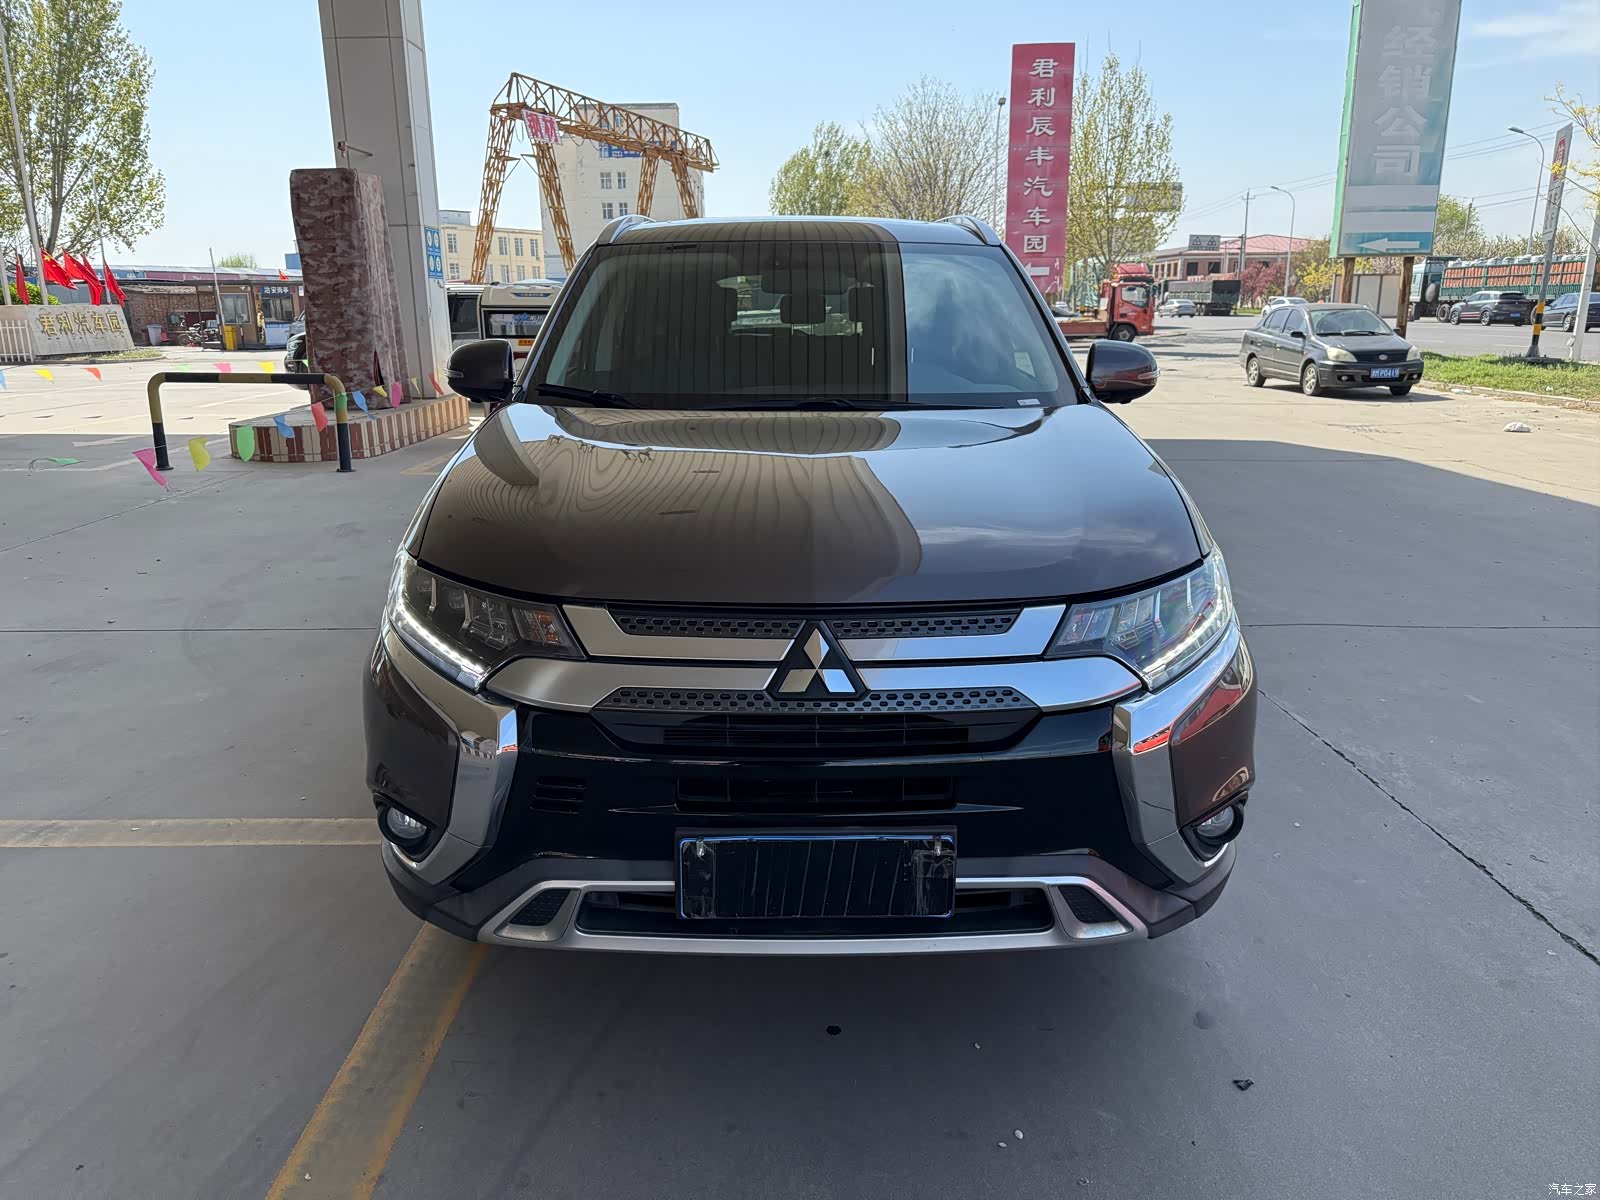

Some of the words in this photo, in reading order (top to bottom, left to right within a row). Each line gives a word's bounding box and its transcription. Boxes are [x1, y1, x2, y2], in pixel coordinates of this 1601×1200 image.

[1022, 58, 1059, 254] 君利辰丰汽车园
[1371, 26, 1436, 178] 经销公司
[38, 311, 125, 337] 君利汽车园
